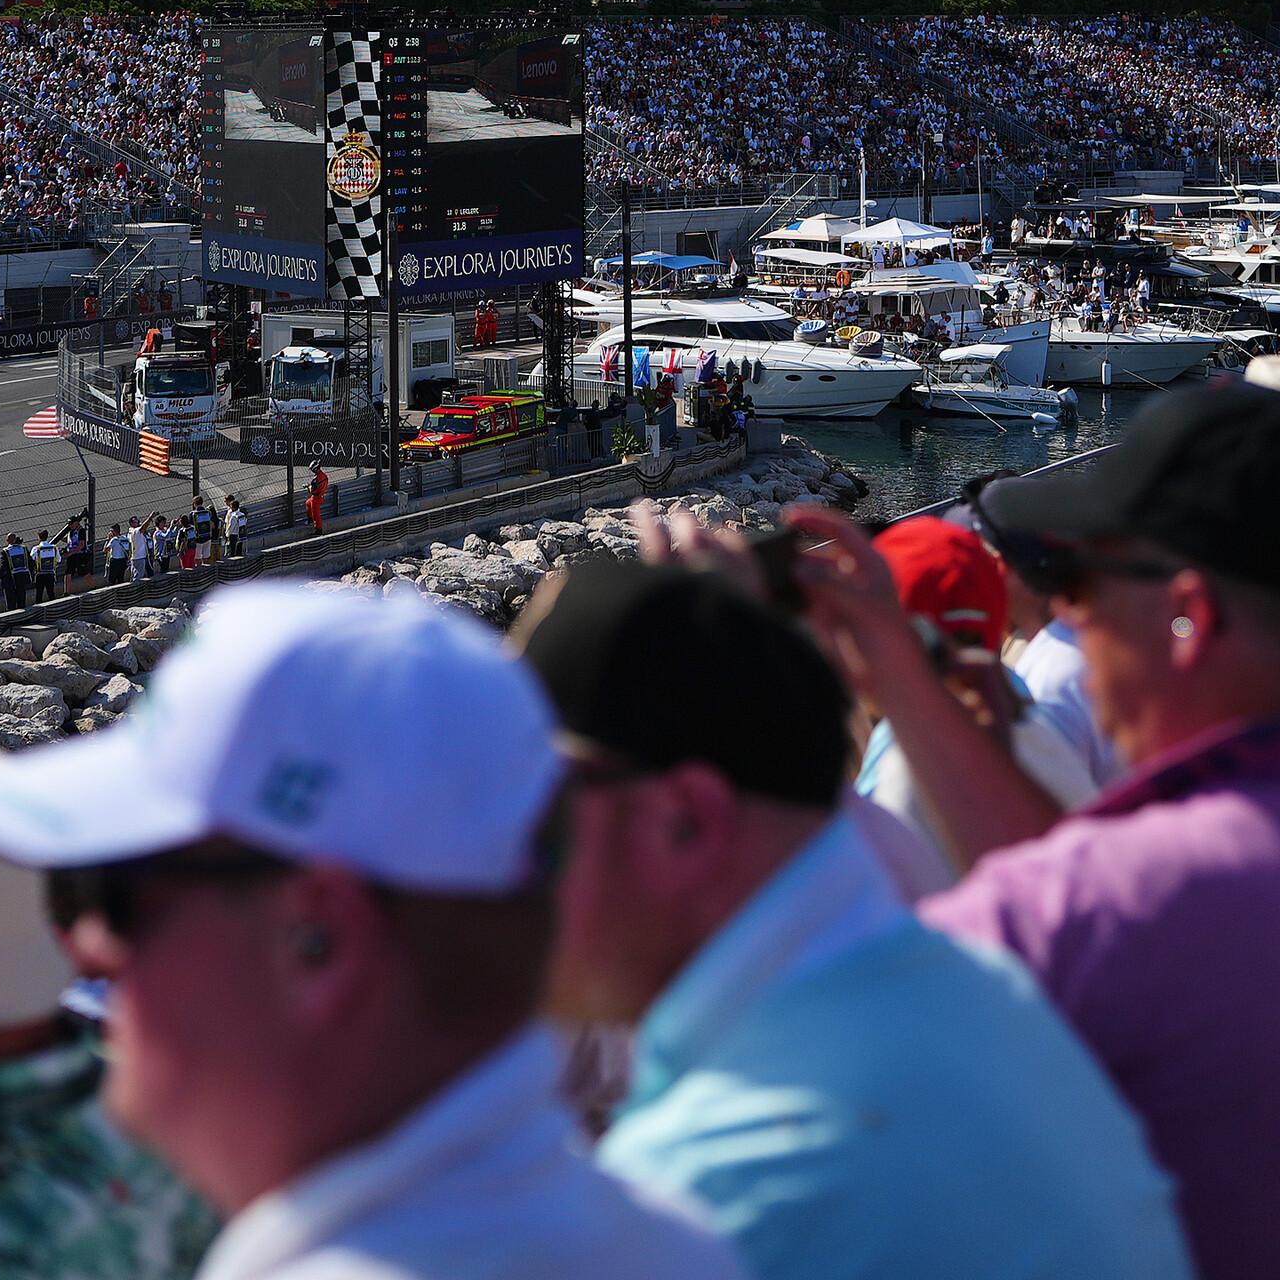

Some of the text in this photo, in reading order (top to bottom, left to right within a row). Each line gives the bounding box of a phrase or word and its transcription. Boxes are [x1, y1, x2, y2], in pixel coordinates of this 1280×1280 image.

[388, 38, 420, 47] Q3 2:38
[282, 63, 307, 81] Lenovo
[522, 60, 557, 78] Lenovo
[453, 222, 467, 232] 31.8
[221, 247, 317, 282] EXPLORA JOURNEYS
[424, 244, 573, 279] EXPLORA JOURNEYS
[168, 398, 195, 408] MILLO
[64, 413, 120, 450] EXPLORA JOURNEYS
